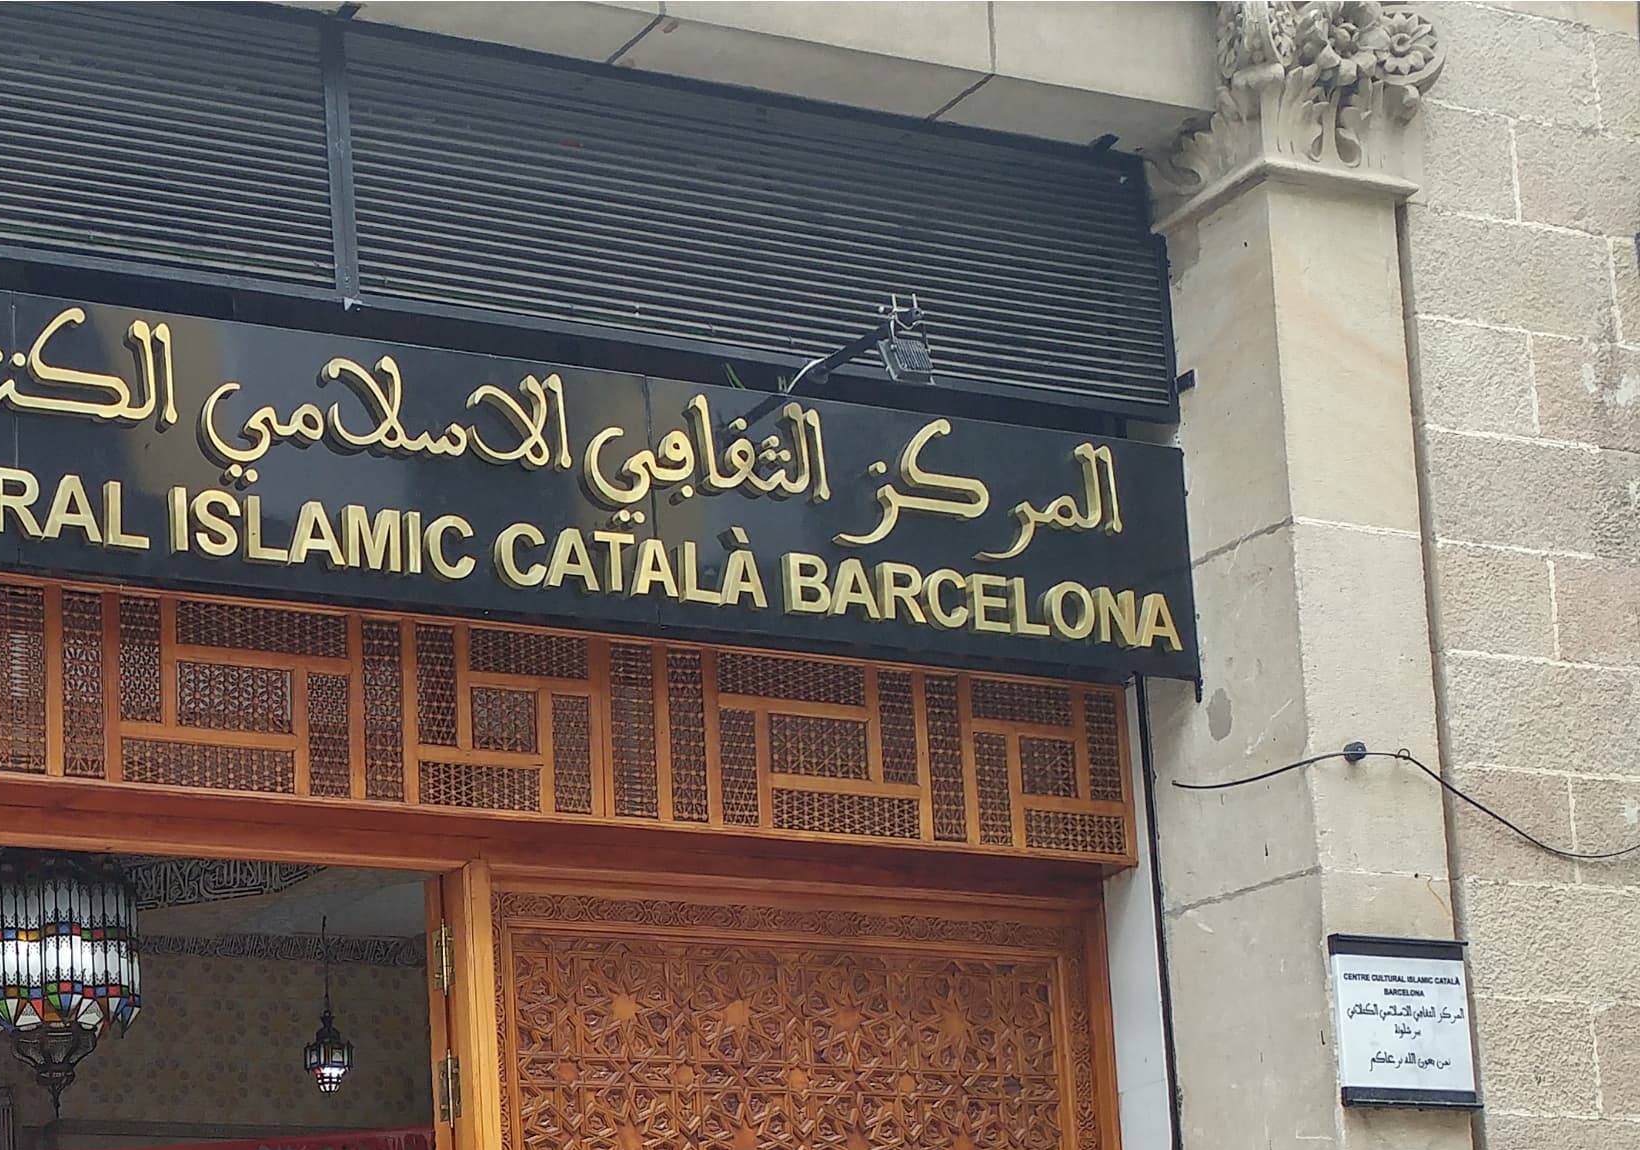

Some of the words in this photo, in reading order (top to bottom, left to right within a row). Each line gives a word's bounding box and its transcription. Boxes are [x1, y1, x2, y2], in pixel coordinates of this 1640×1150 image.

[168, 486, 476, 579] ISLAMIC
[494, 523, 768, 608] CATALÀ
[785, 553, 1182, 650] BARCELONA
[1344, 973, 1370, 981] CENTRE
[1372, 974, 1406, 983] CULTURAL
[1407, 976, 1433, 984] ISLAMIC
[1434, 976, 1460, 985] CATALÀ
[1384, 988, 1424, 997] BARCELONA
